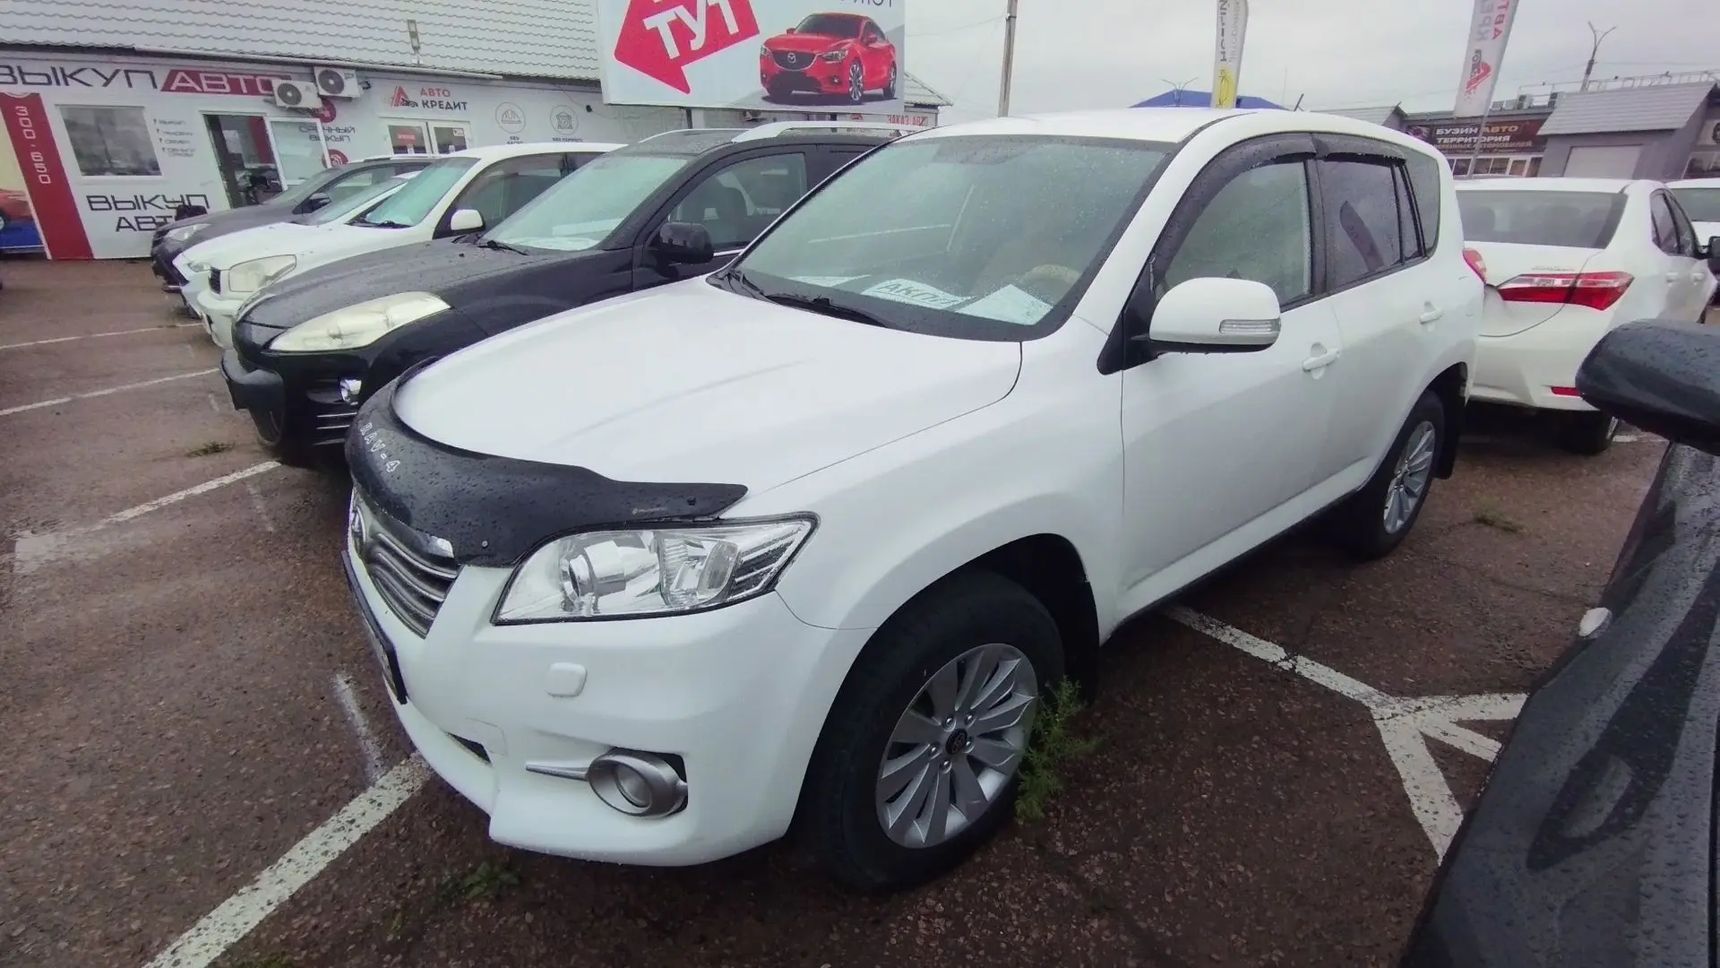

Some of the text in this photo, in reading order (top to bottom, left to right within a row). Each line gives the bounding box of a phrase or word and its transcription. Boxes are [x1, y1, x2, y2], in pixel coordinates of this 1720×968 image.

[643, 0, 740, 59] ТУТ
[0, 65, 158, 89] ВЫКУП
[421, 88, 450, 98] АВТО
[422, 99, 468, 110] КРЕДИТ
[1436, 127, 1478, 135] БУЗИН
[1437, 135, 1511, 144] ТЕРРИТОРИЯ
[86, 194, 210, 211] ВЫКУП
[115, 216, 173, 232] АВТ
[360, 422, 401, 473] RAV-4
